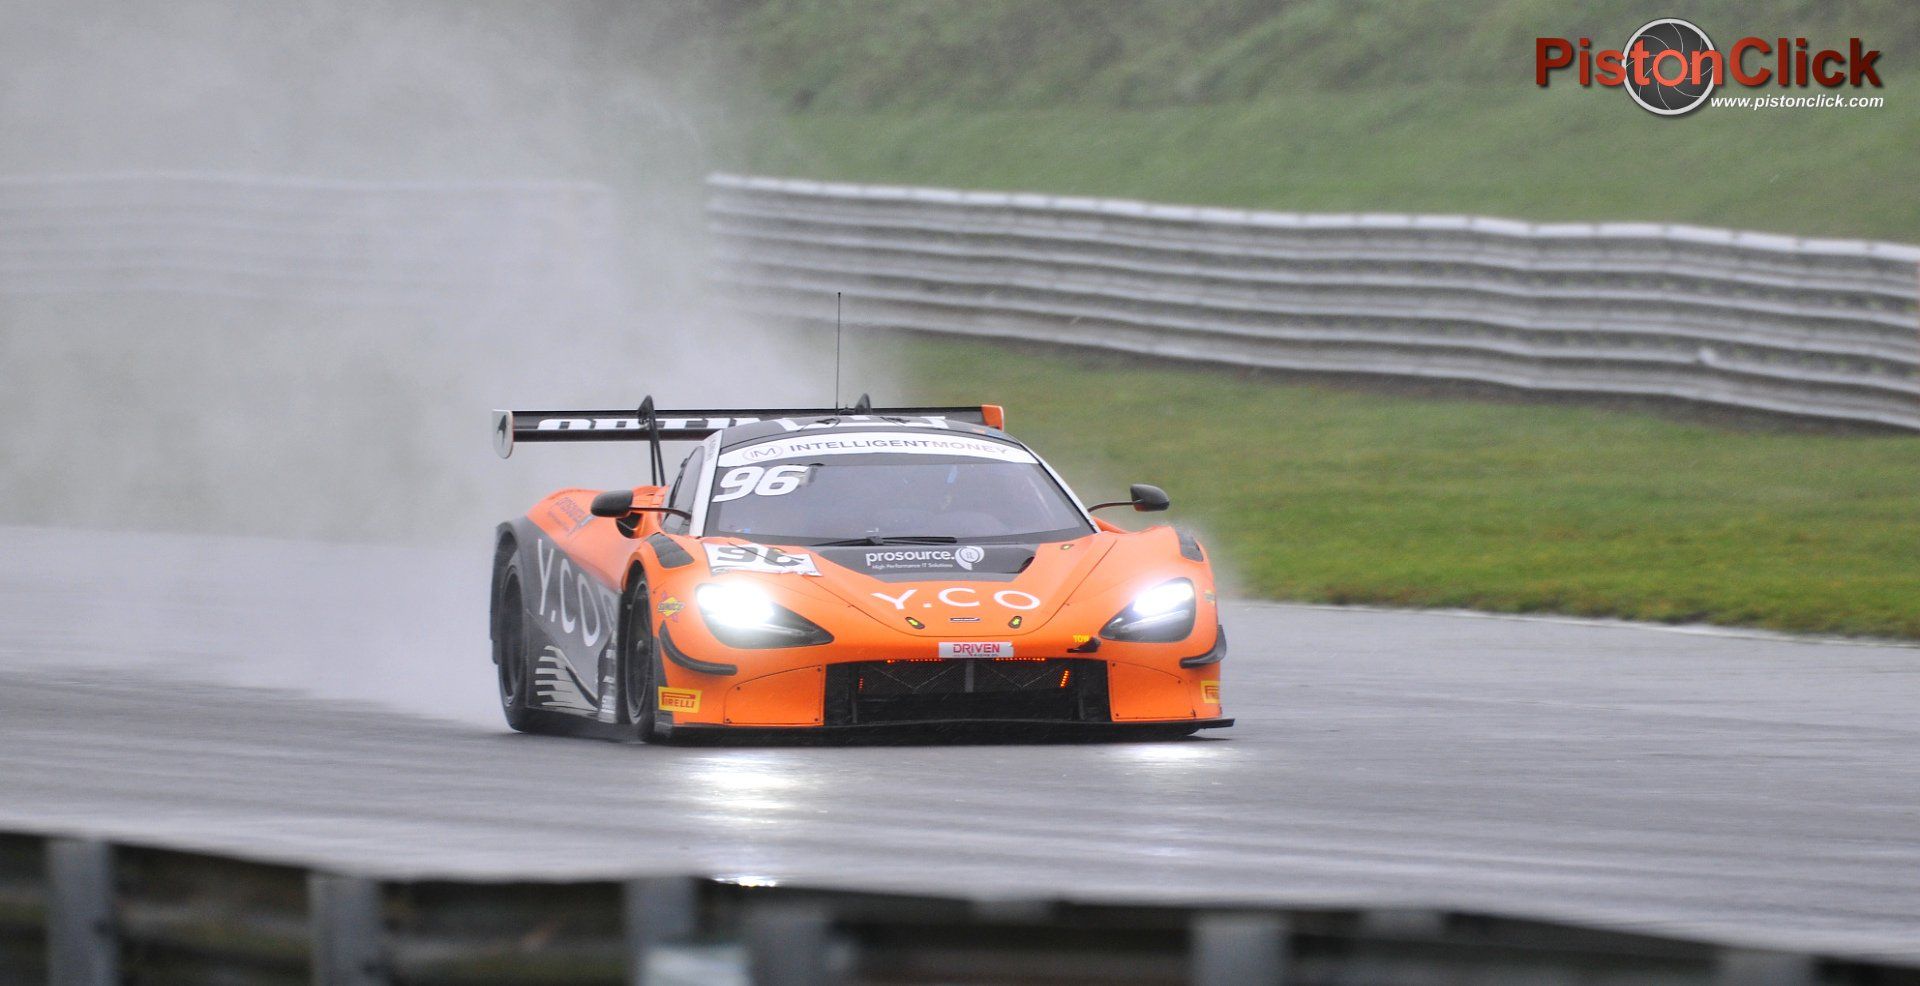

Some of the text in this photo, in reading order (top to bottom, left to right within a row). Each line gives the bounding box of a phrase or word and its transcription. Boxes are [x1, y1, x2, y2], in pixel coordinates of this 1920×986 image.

[712, 465, 810, 502] 96
[871, 587, 1041, 610] Y.CO
[953, 643, 1000, 655] DRIVEN
